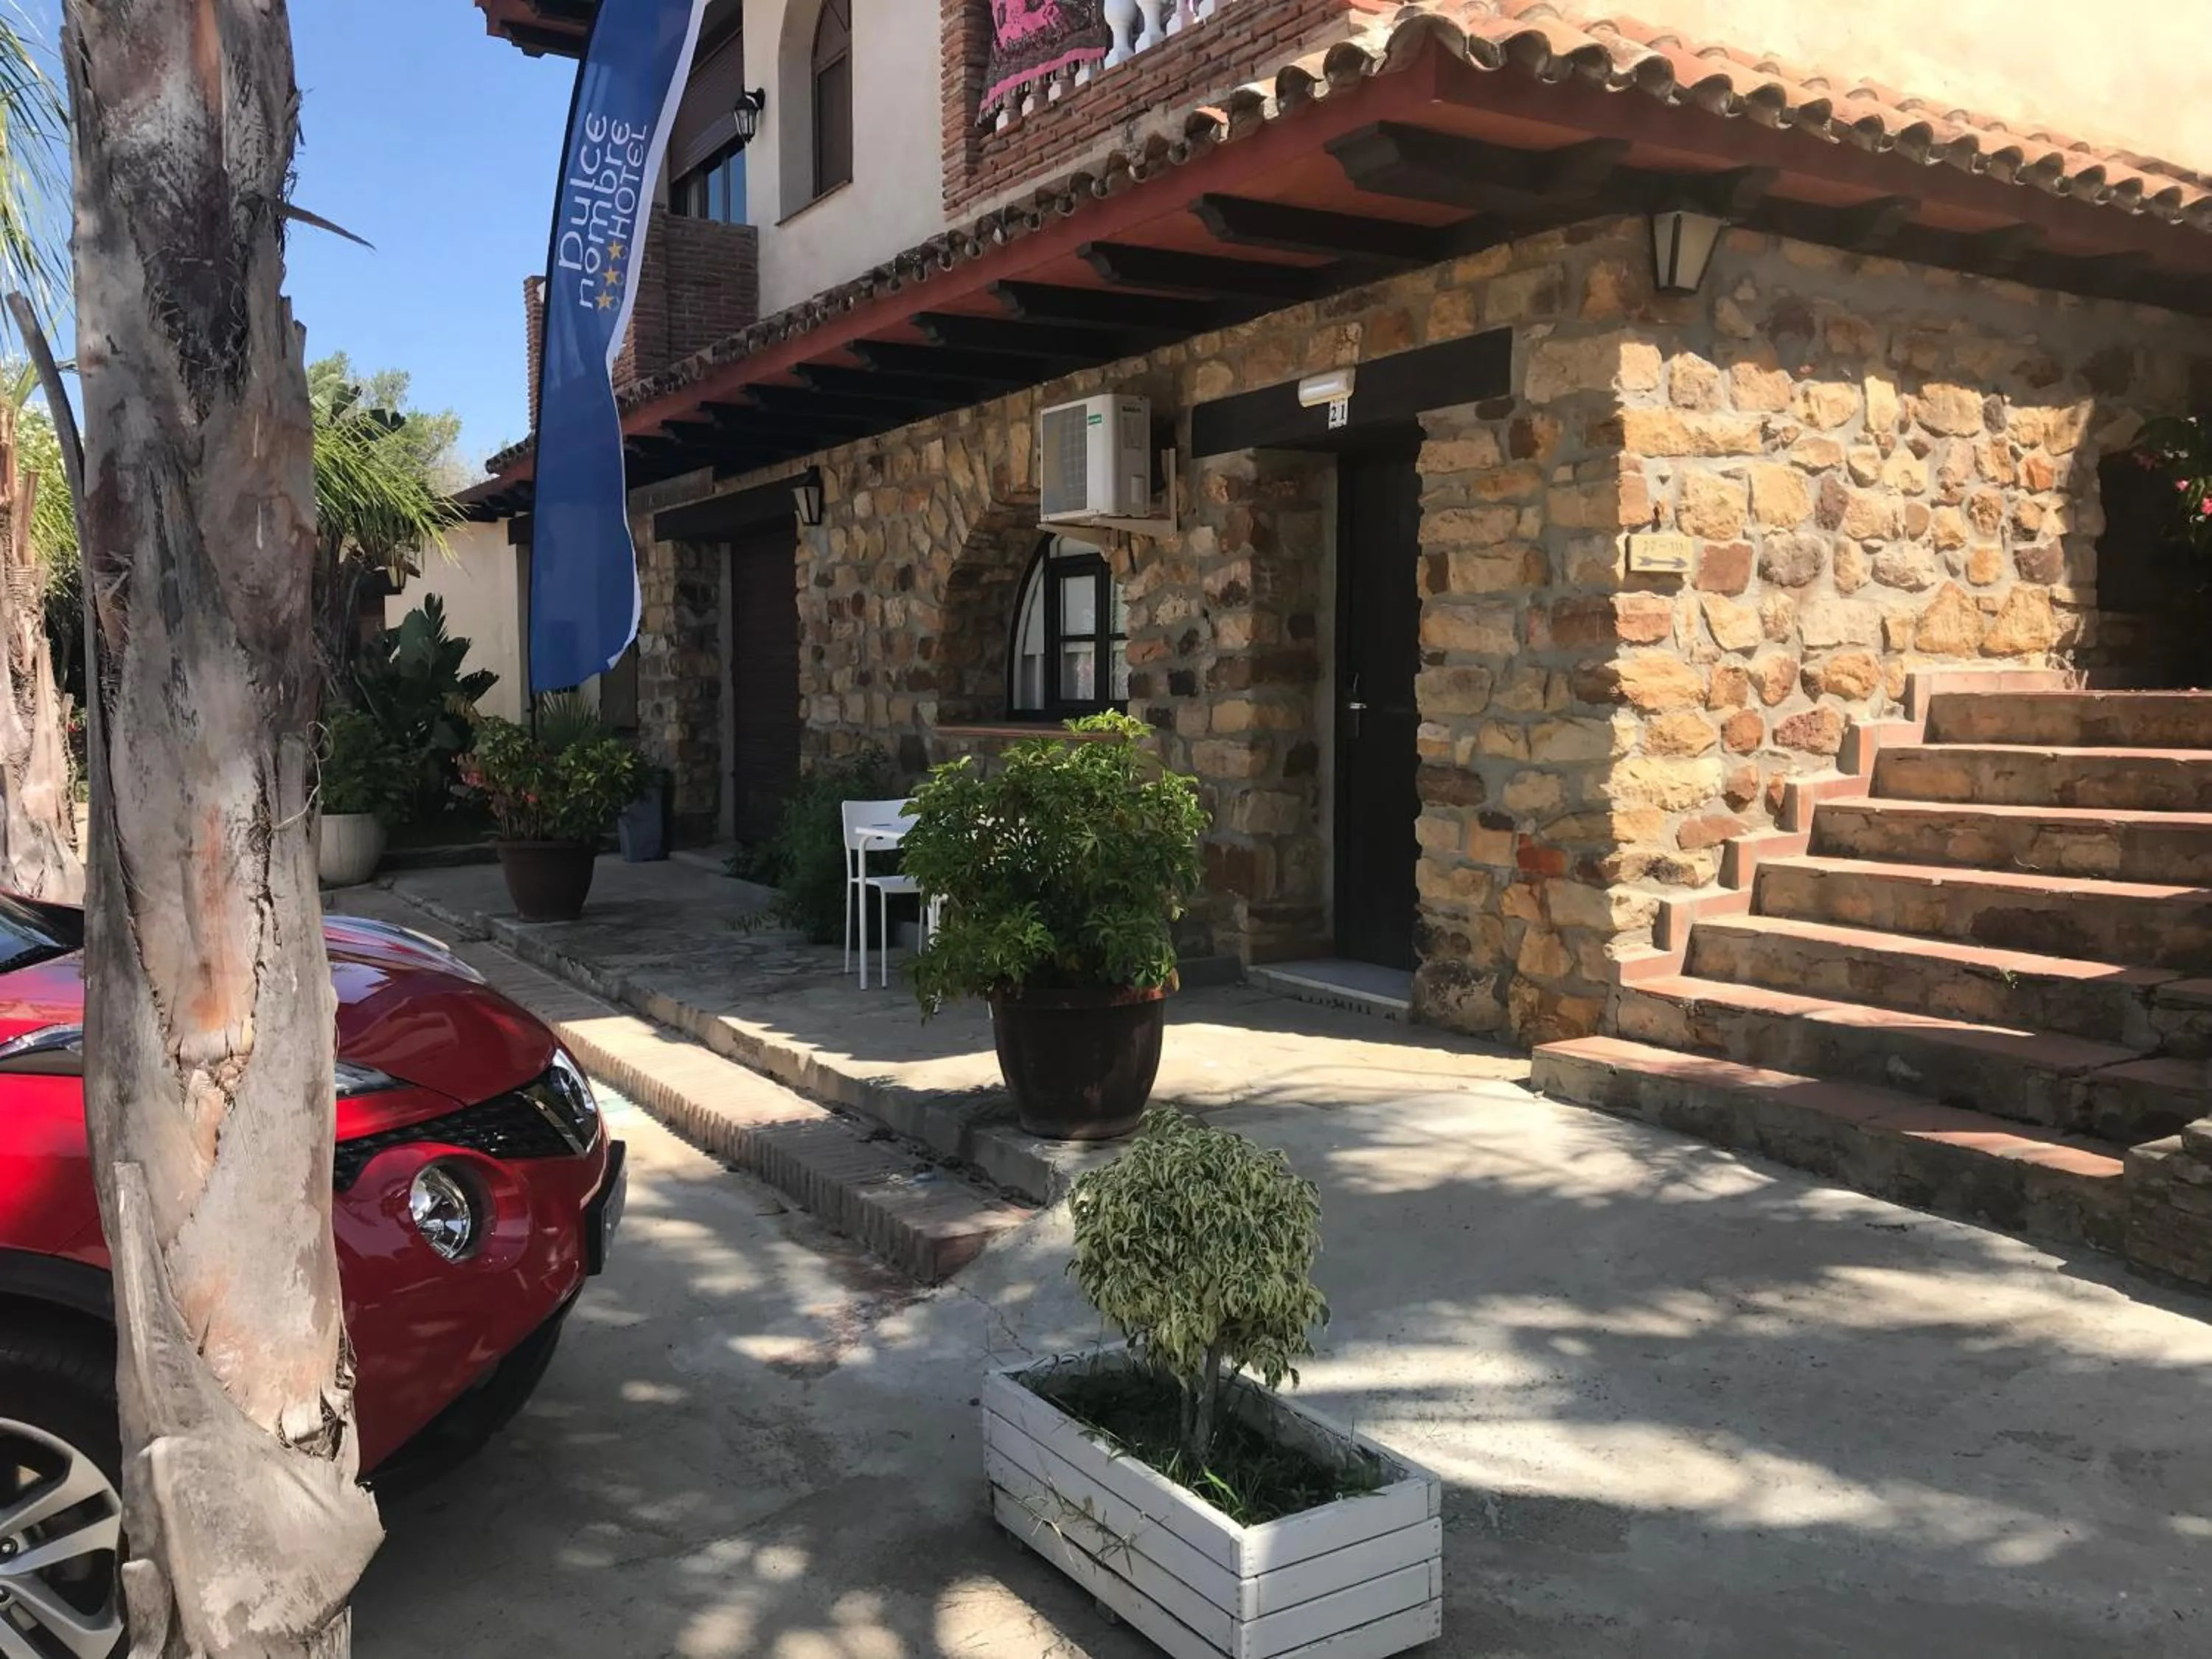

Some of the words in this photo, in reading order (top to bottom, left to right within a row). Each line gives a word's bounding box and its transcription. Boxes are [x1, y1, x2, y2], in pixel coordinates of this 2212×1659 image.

[558, 112, 607, 271] Dulce
[579, 119, 630, 308] nombre
[608, 125, 647, 239] HOTEL
[1330, 405, 1345, 422] 21
